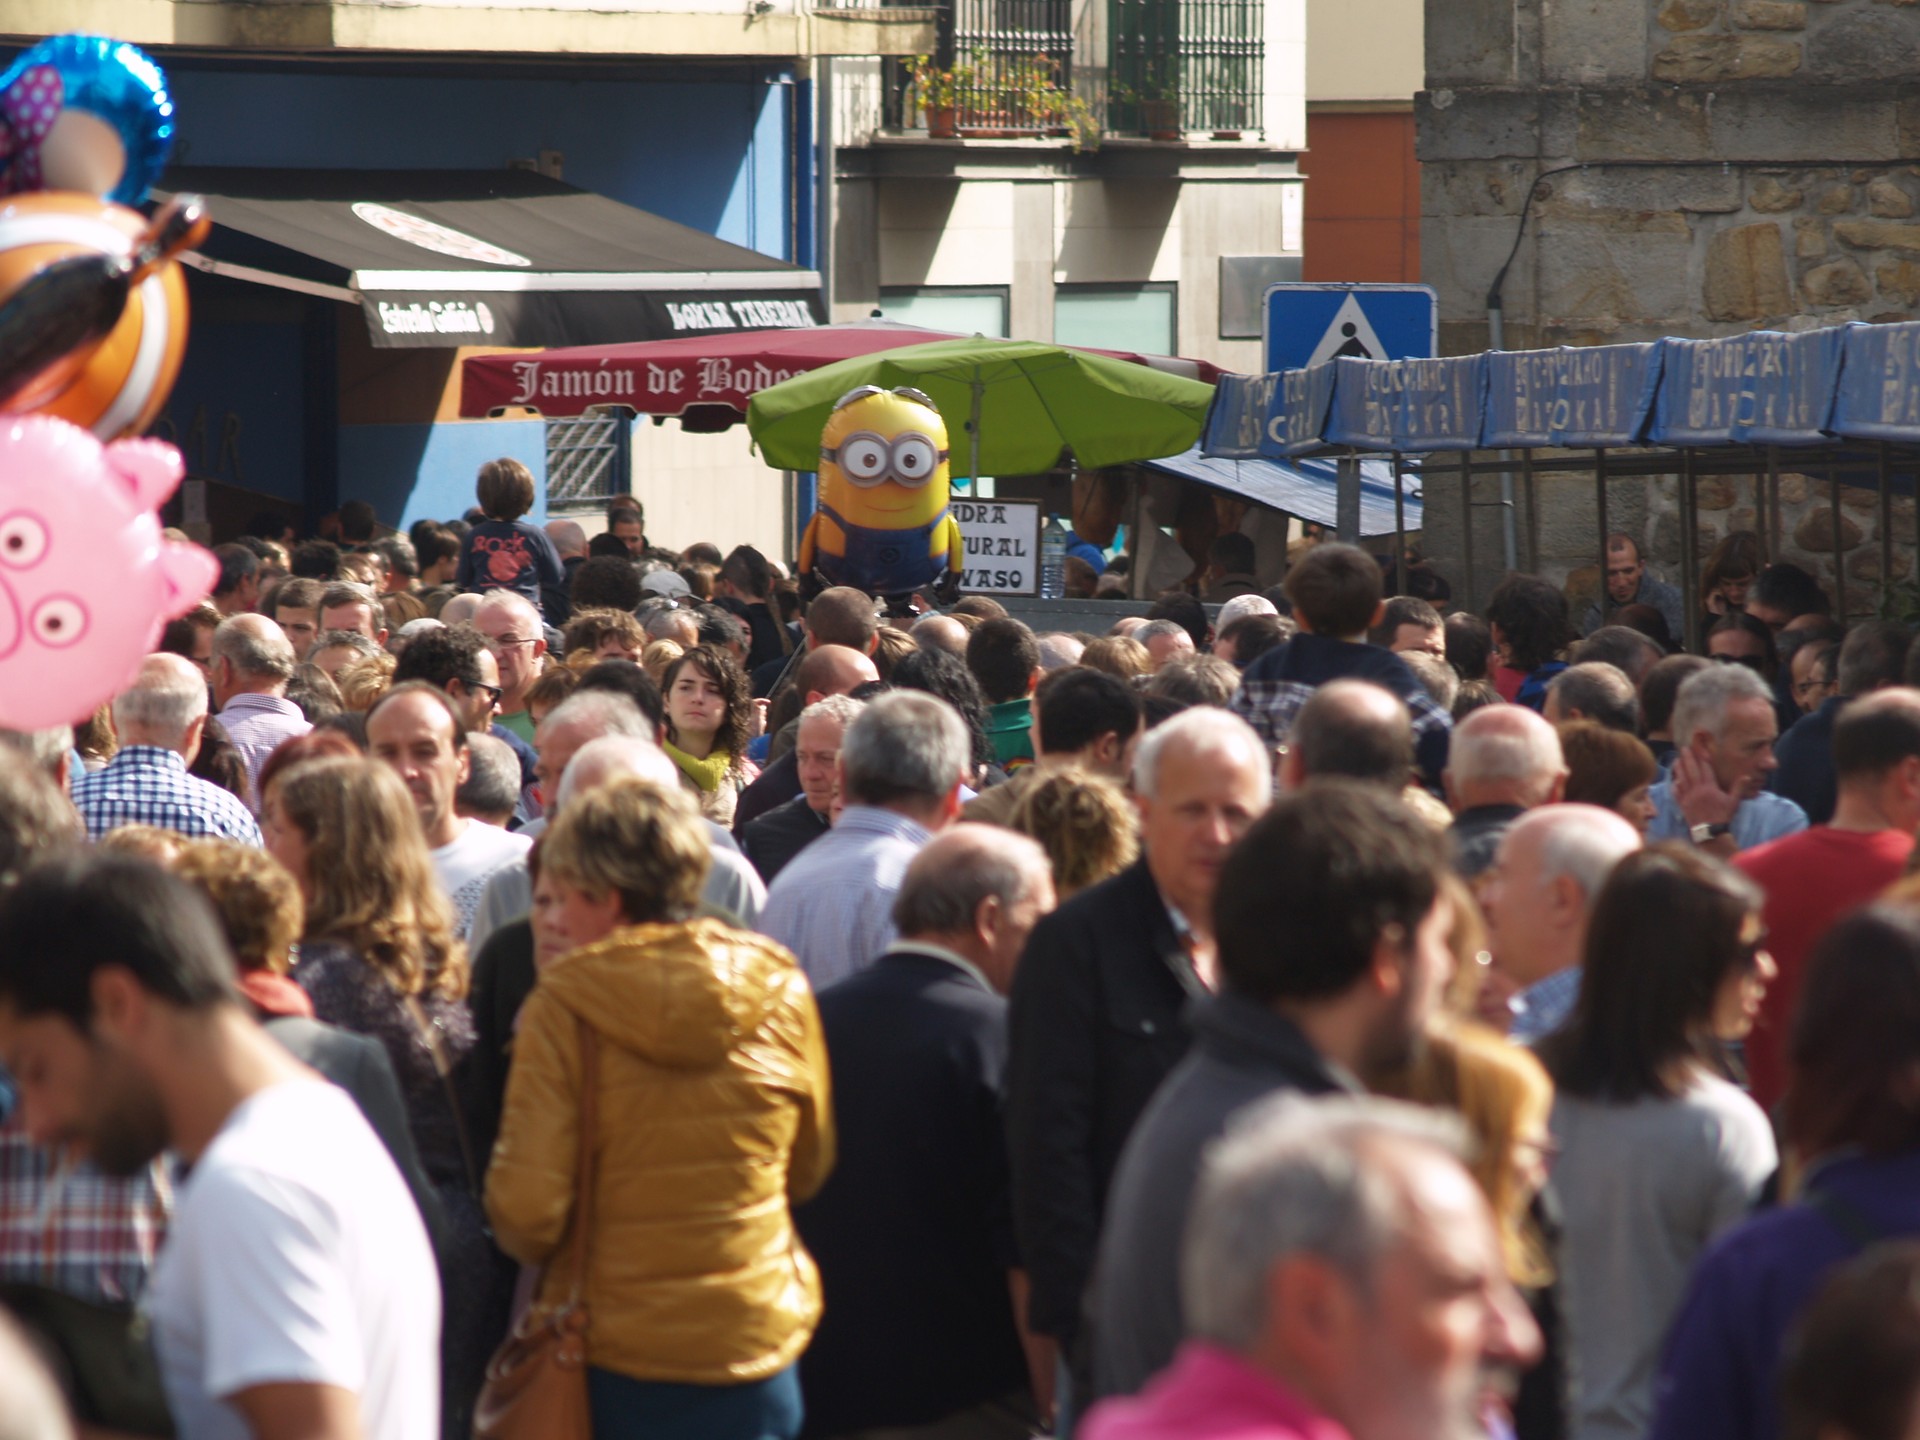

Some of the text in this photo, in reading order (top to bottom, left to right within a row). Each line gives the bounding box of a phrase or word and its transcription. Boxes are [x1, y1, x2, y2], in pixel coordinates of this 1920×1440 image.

[730, 300, 817, 328] TABERNA
[511, 358, 807, 402] Jamón de Bode
[961, 536, 1026, 557] URAL
[961, 569, 1022, 588] VASO
